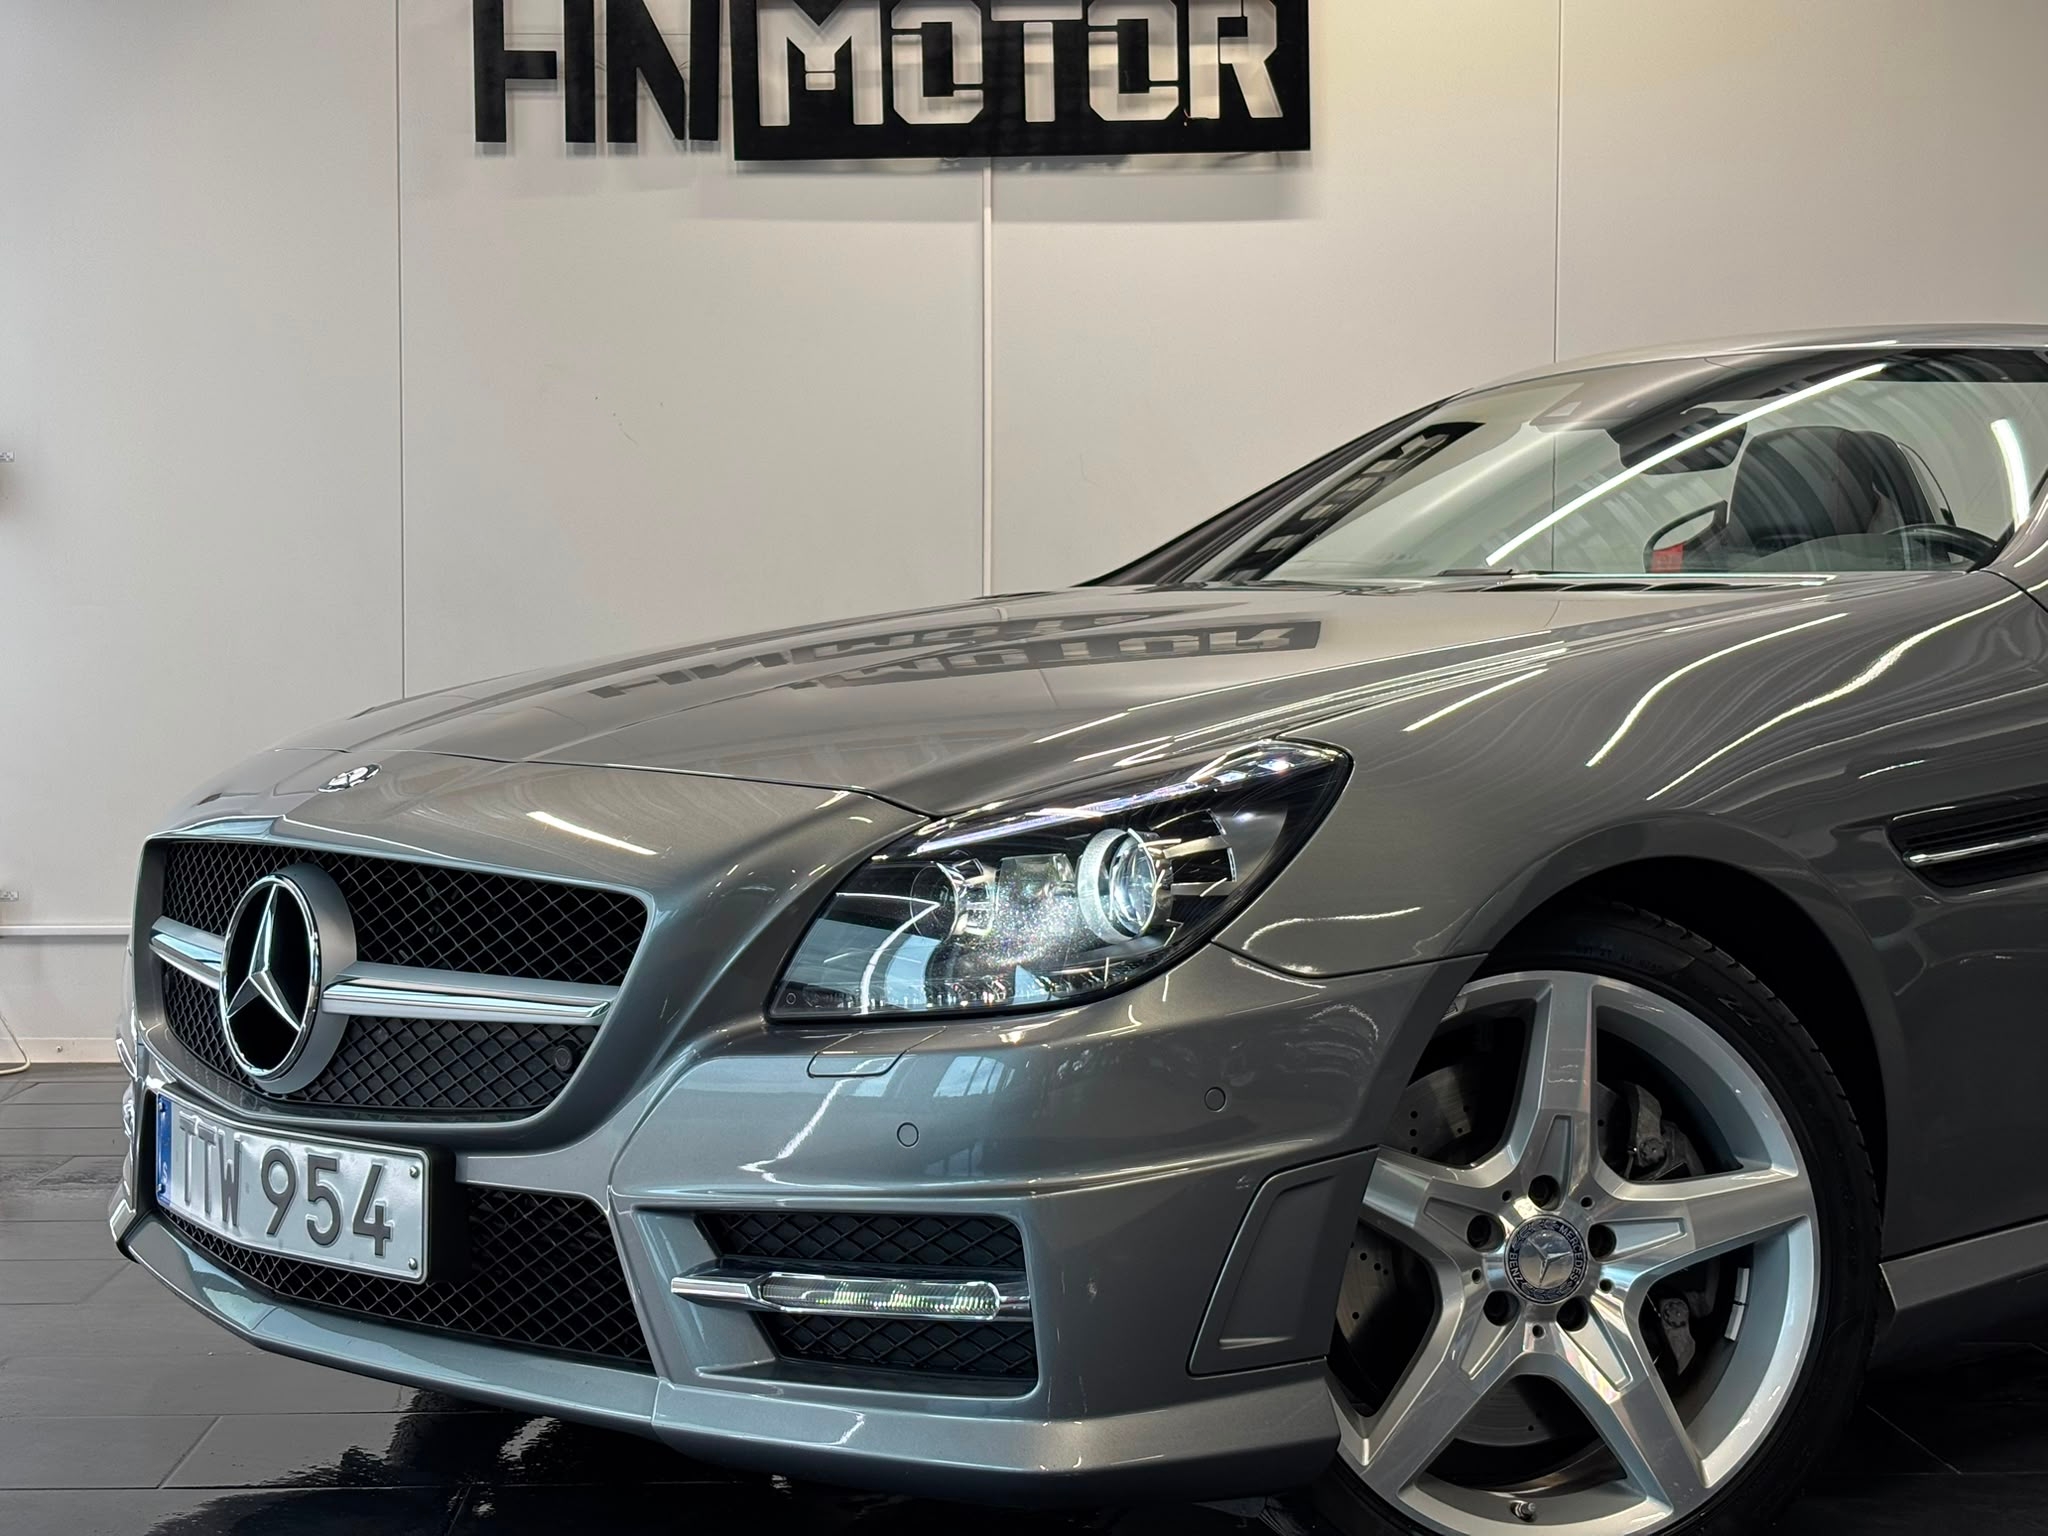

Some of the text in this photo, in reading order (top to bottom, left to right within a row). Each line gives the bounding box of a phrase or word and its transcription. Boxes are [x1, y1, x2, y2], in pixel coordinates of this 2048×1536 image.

[756, 0, 1284, 127] MOTOR
[179, 1111, 393, 1257] TTW 954
[1509, 1252, 1524, 1284] BENZ
[1558, 1224, 1584, 1282] MERCEDES
